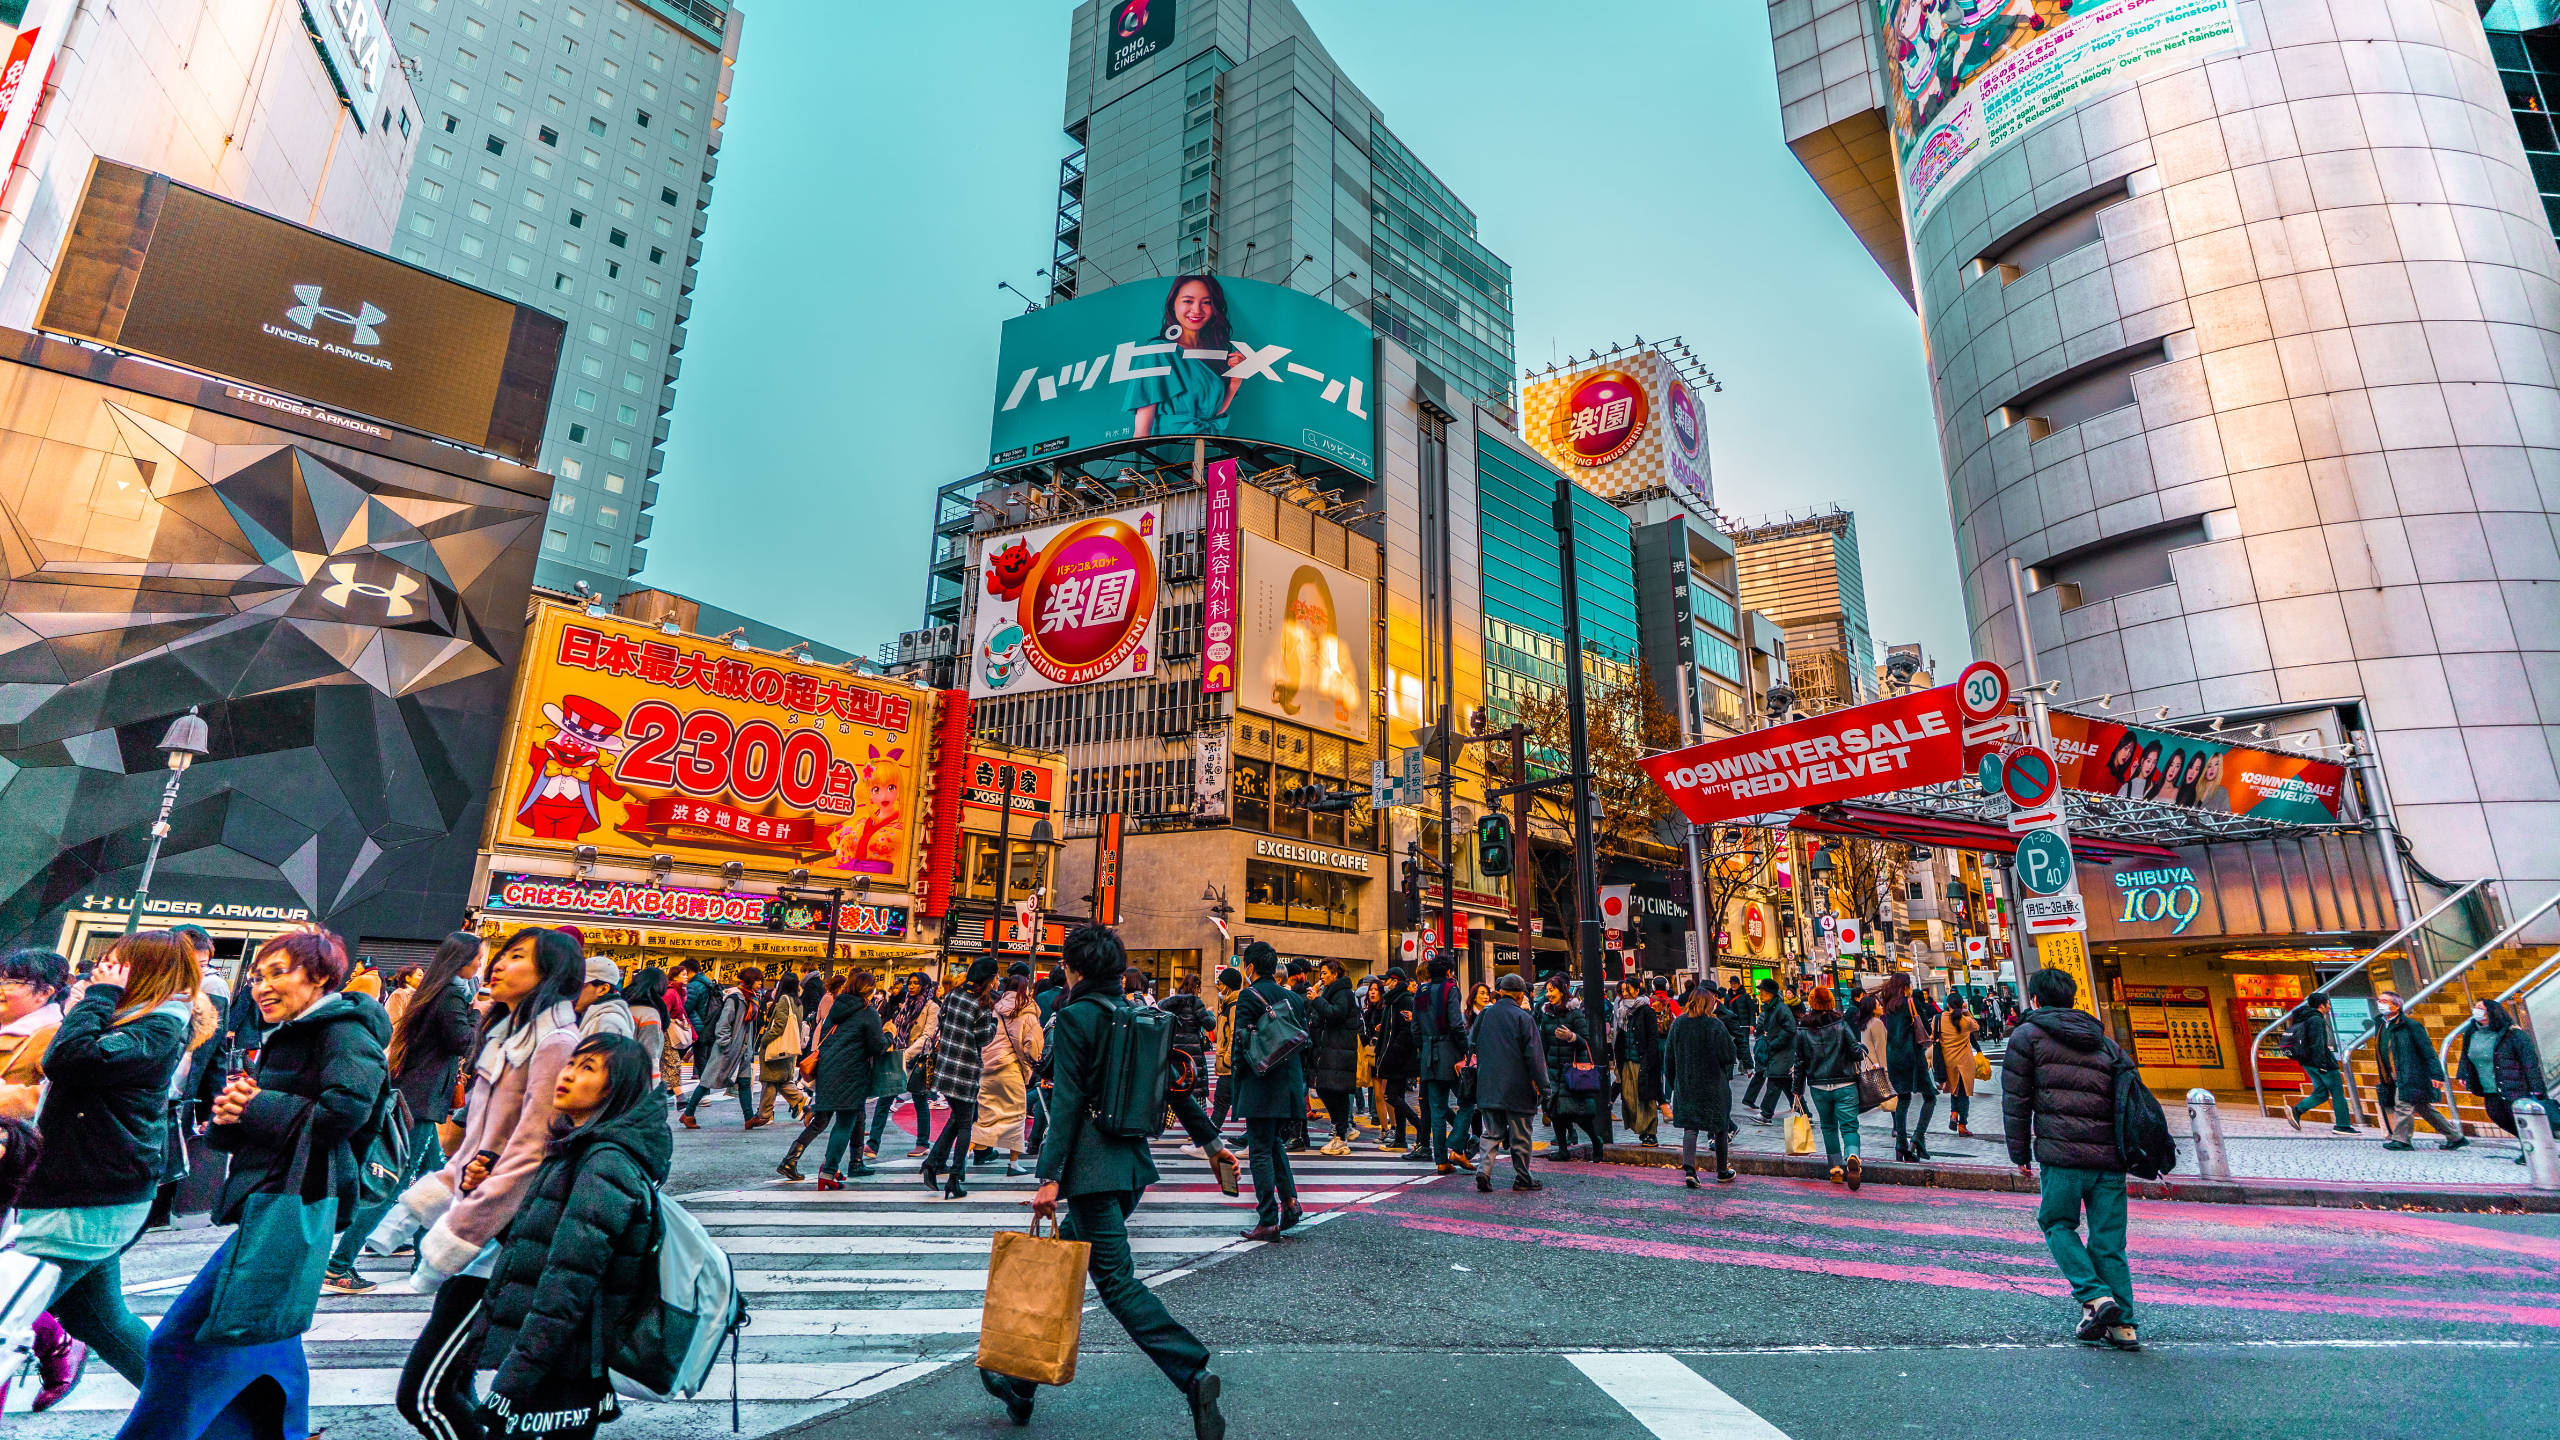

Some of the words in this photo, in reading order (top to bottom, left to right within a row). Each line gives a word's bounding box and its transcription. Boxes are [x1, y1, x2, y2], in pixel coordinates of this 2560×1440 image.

[2096, 7, 2124, 23] Next
[2126, 19, 2162, 38] Stop?
[1114, 41, 1156, 71] CINEMAS
[1115, 36, 1145, 61] TOHO
[1981, 73, 2017, 101] 2019.1.23
[2018, 47, 2058, 75] Release!
[2016, 104, 2036, 122] again
[2041, 80, 2079, 106] Brightest
[2080, 65, 2112, 87] Melody
[2119, 54, 2142, 68] Over
[2144, 47, 2162, 58] The
[2164, 39, 2186, 52] Next
[1984, 96, 2023, 125] 2019.1.30
[2024, 70, 2065, 98] Release!
[1989, 122, 2023, 149] 2019.2.6
[2025, 98, 2065, 125] Release!
[263, 323, 320, 348] UNDER
[1001, 324, 1368, 421] ハッピーメール
[258, 395, 312, 417] UNDER
[1568, 396, 1633, 443] 楽園
[1674, 401, 1695, 441] 楽園
[1322, 440, 1368, 467] ハッピーメール
[1556, 442, 1593, 467] EXCITING
[1595, 421, 1645, 466] AMUSEMENT
[1141, 518, 1153, 529] 40
[1209, 489, 1231, 620] 品川美容外科
[1037, 568, 1136, 635] 楽園
[1022, 633, 1067, 682] EXCITING
[1070, 614, 1148, 683] AMUSEMENT
[1134, 653, 1146, 663] 30
[560, 623, 911, 733] 日本最大級の超大型店
[1967, 675, 1999, 706] 30
[614, 700, 832, 810] 2300
[827, 760, 858, 798] 台
[2014, 747, 2034, 758] 20-7
[1411, 751, 1421, 800] 道玄坂下
[1701, 783, 1730, 796] WITH
[817, 795, 853, 813] OVER
[671, 804, 792, 840] 渋谷地区合計
[2027, 833, 2052, 846] 7-20
[1257, 839, 1328, 865] EXCELSIOR
[1330, 852, 1369, 871] CAFFÉ
[2027, 848, 2049, 888] P
[2046, 867, 2062, 887] 40
[2114, 866, 2196, 888] SHIBUYA
[117, 897, 203, 915] UNDER
[207, 903, 309, 921] ARMOUR
[2118, 884, 2200, 935] 109
[647, 936, 667, 945] 無双
[669, 939, 693, 947] NEXT
[752, 943, 769, 952] 無双
[770, 945, 794, 953] NEXT
[793, 945, 819, 953] STAGE
[1425, 933, 1435, 942] 40
[720, 960, 744, 972] NEXT
